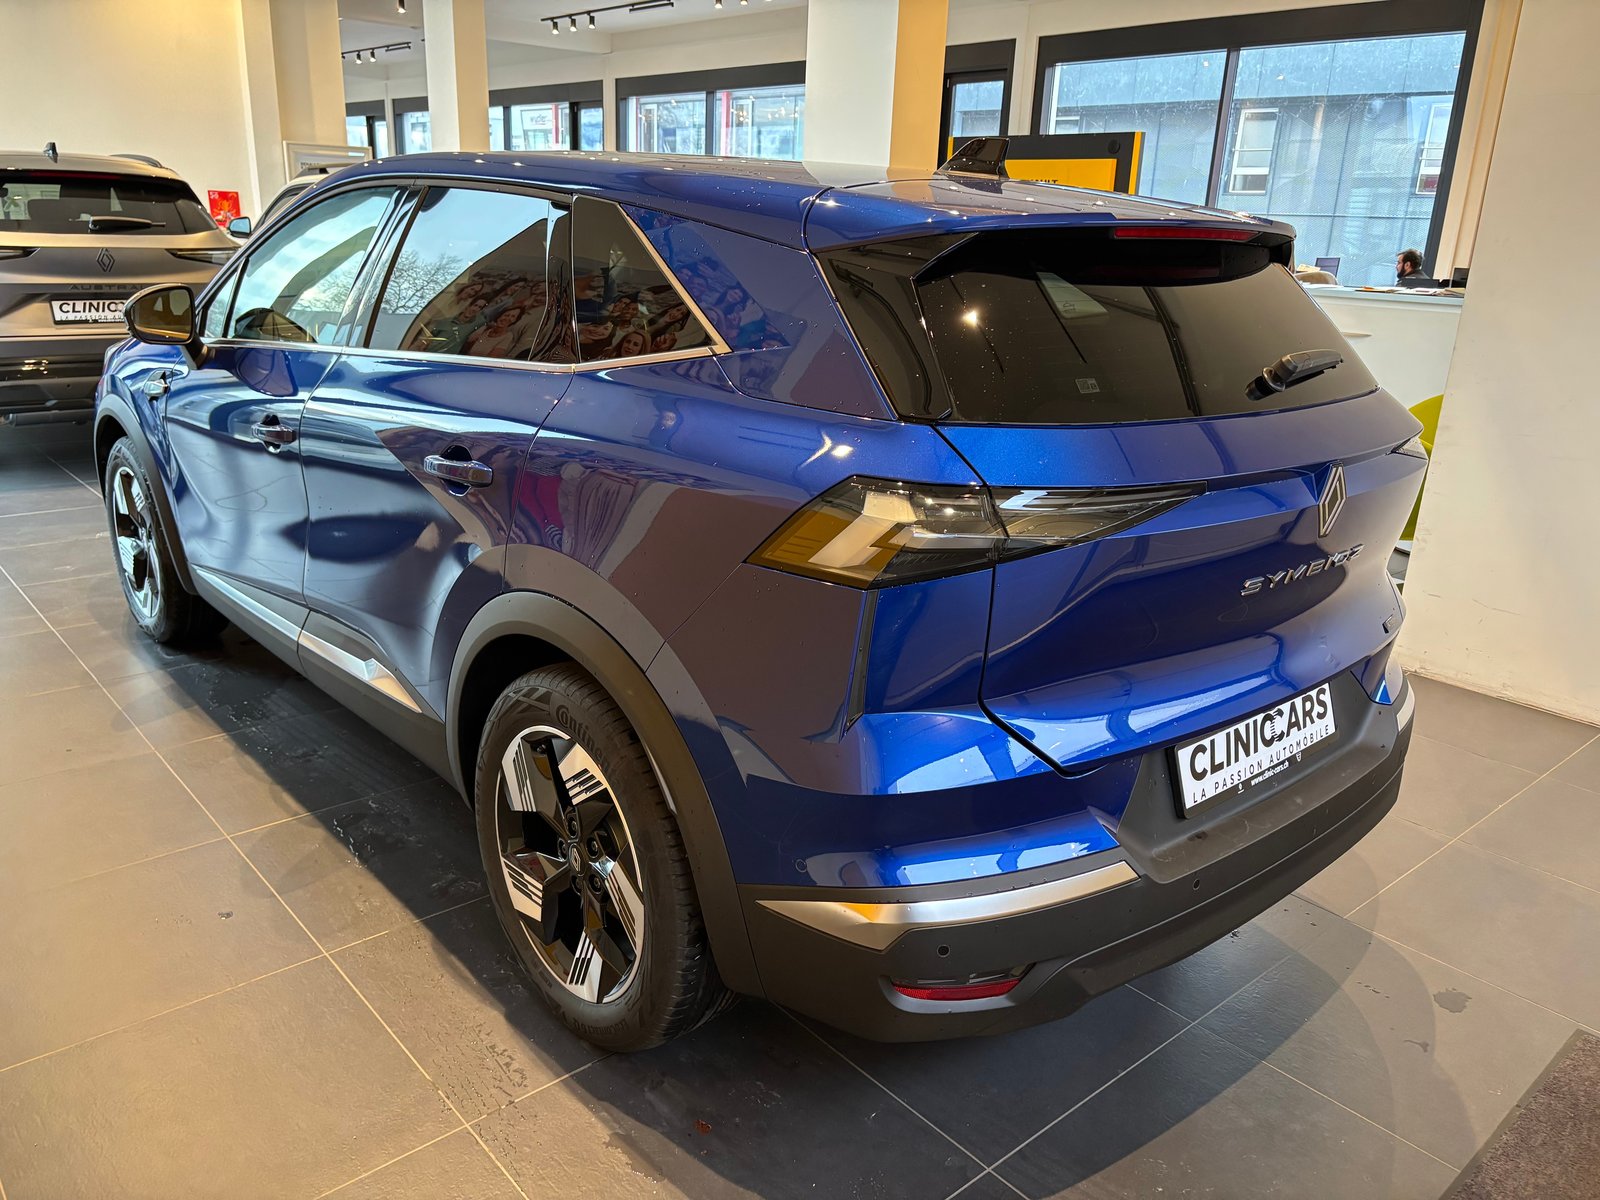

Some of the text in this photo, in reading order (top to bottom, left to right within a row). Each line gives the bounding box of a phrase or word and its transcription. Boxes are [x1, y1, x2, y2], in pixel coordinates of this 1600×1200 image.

[1240, 543, 1366, 597] SYMBIOZ
[1193, 724, 1329, 804] LA PASSION AUTOMOBILE
